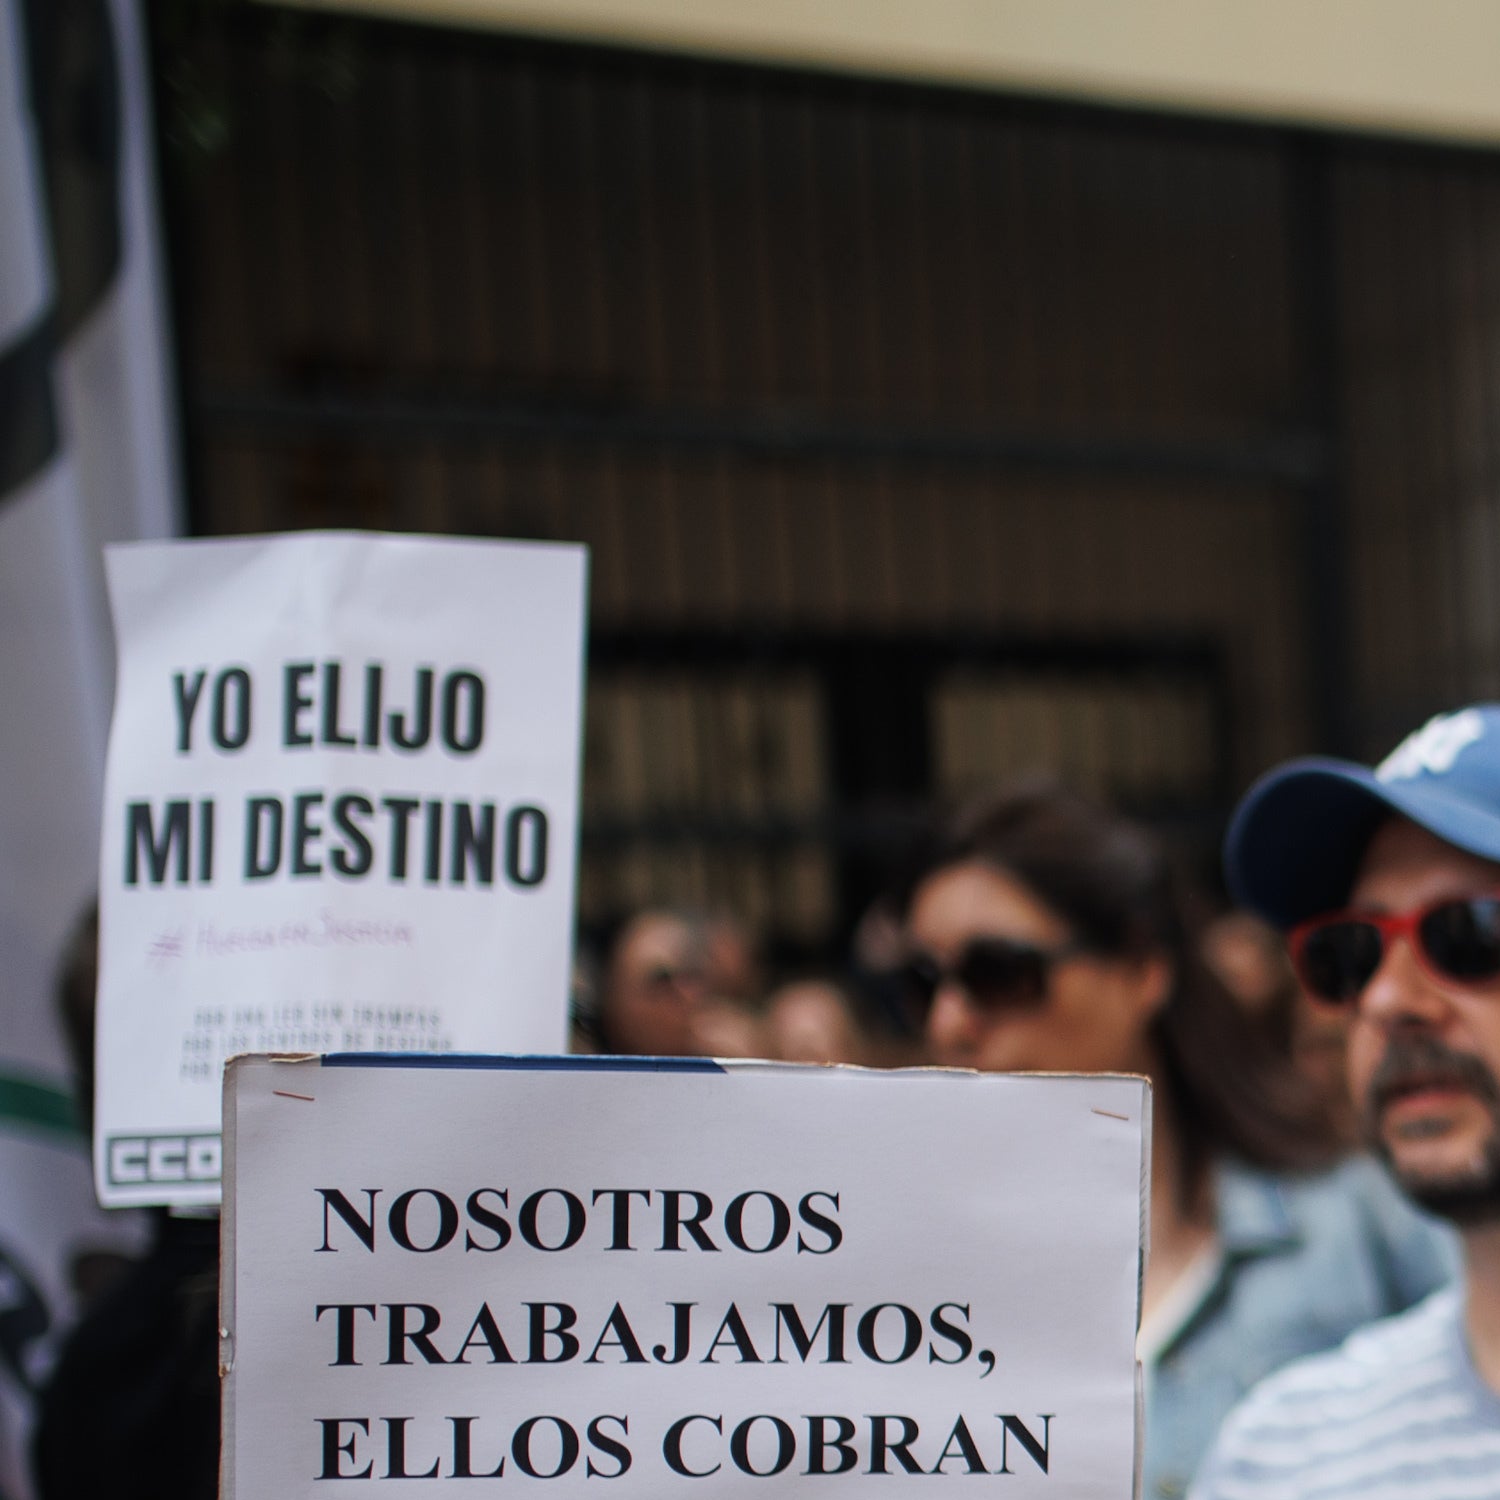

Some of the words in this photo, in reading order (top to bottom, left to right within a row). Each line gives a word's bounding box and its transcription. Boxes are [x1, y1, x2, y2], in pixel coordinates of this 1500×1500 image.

[173, 664, 253, 754] YO
[282, 661, 487, 756] ELIJO
[124, 798, 215, 887] MI
[243, 791, 550, 889] DESTINO
[110, 1138, 222, 1183] CCO
[314, 1186, 844, 1255] NOSOTROS
[315, 1301, 997, 1377] TRABAJAMOS,
[313, 1414, 632, 1481] ELLOS
[662, 1414, 1053, 1478] COBRAN
